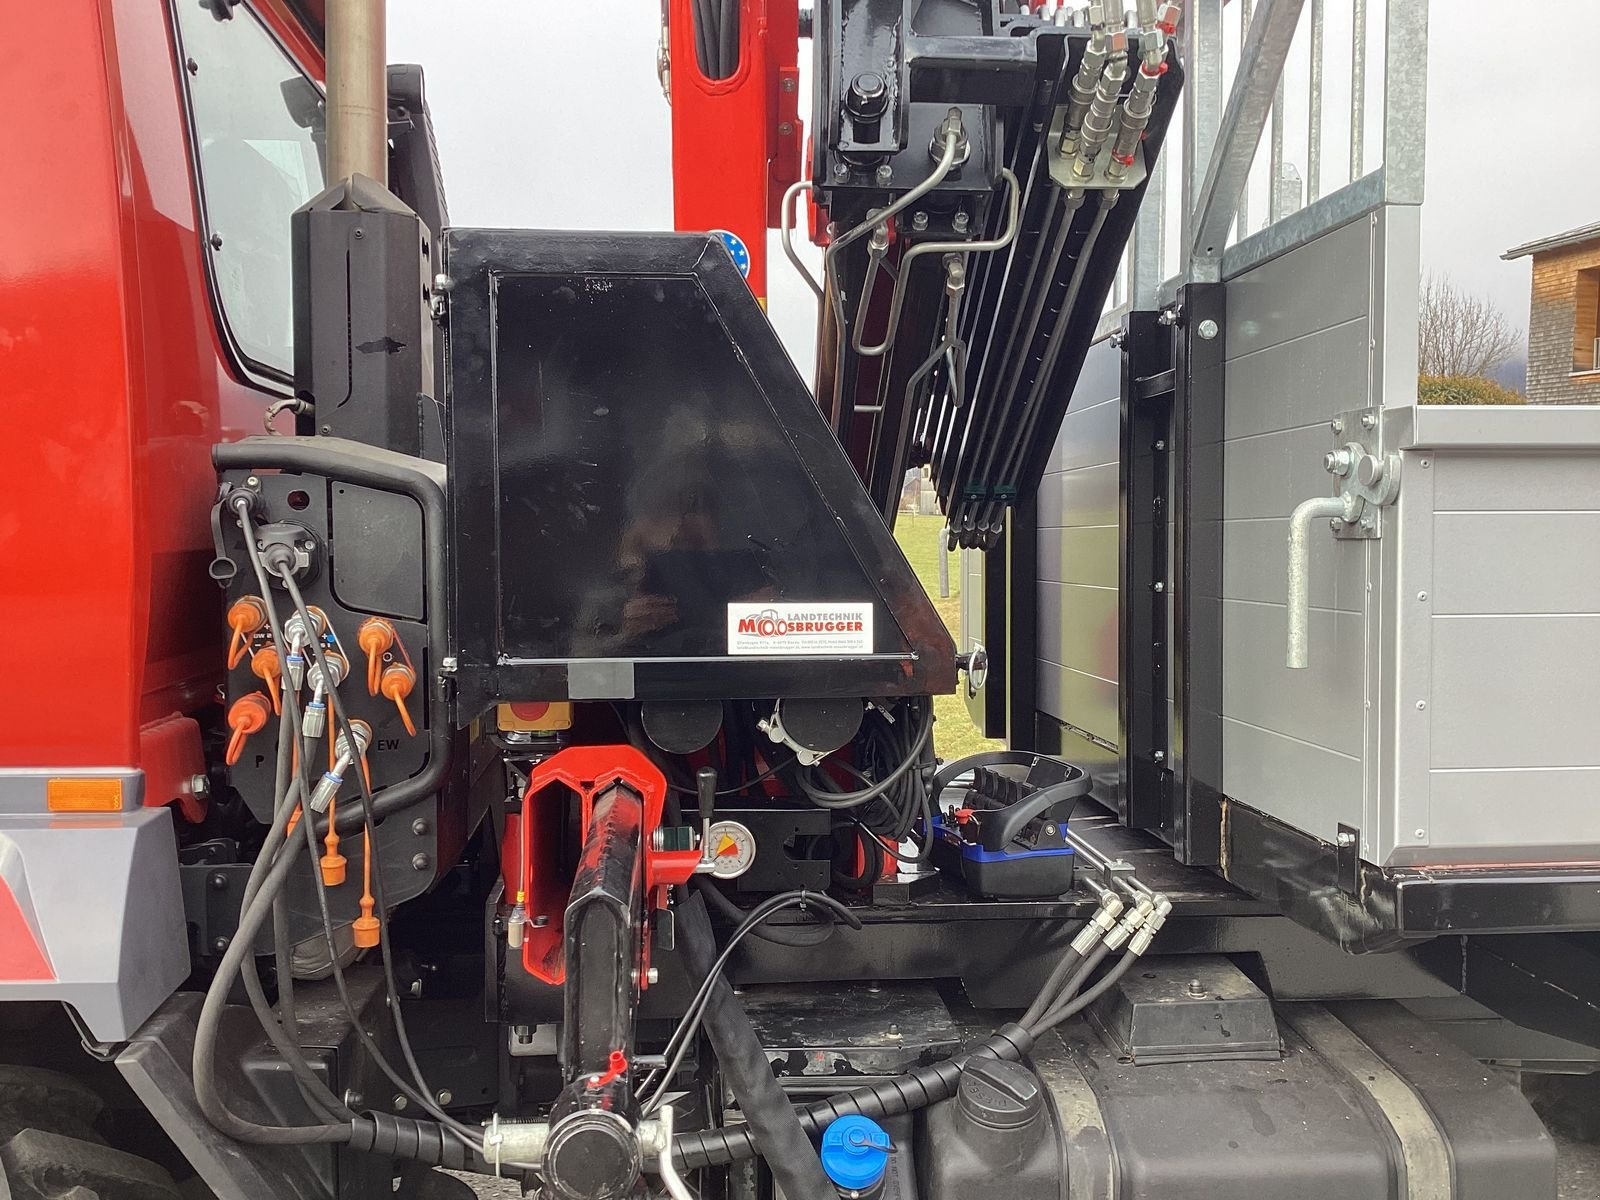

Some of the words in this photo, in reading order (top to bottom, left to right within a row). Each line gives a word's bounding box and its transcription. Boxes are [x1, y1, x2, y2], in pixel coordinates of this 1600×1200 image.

[787, 612, 863, 621] LANDTECHNIK
[738, 619, 863, 636] MOOSBRUGGER
[377, 739, 400, 751] EW
[255, 755, 265, 768] P
